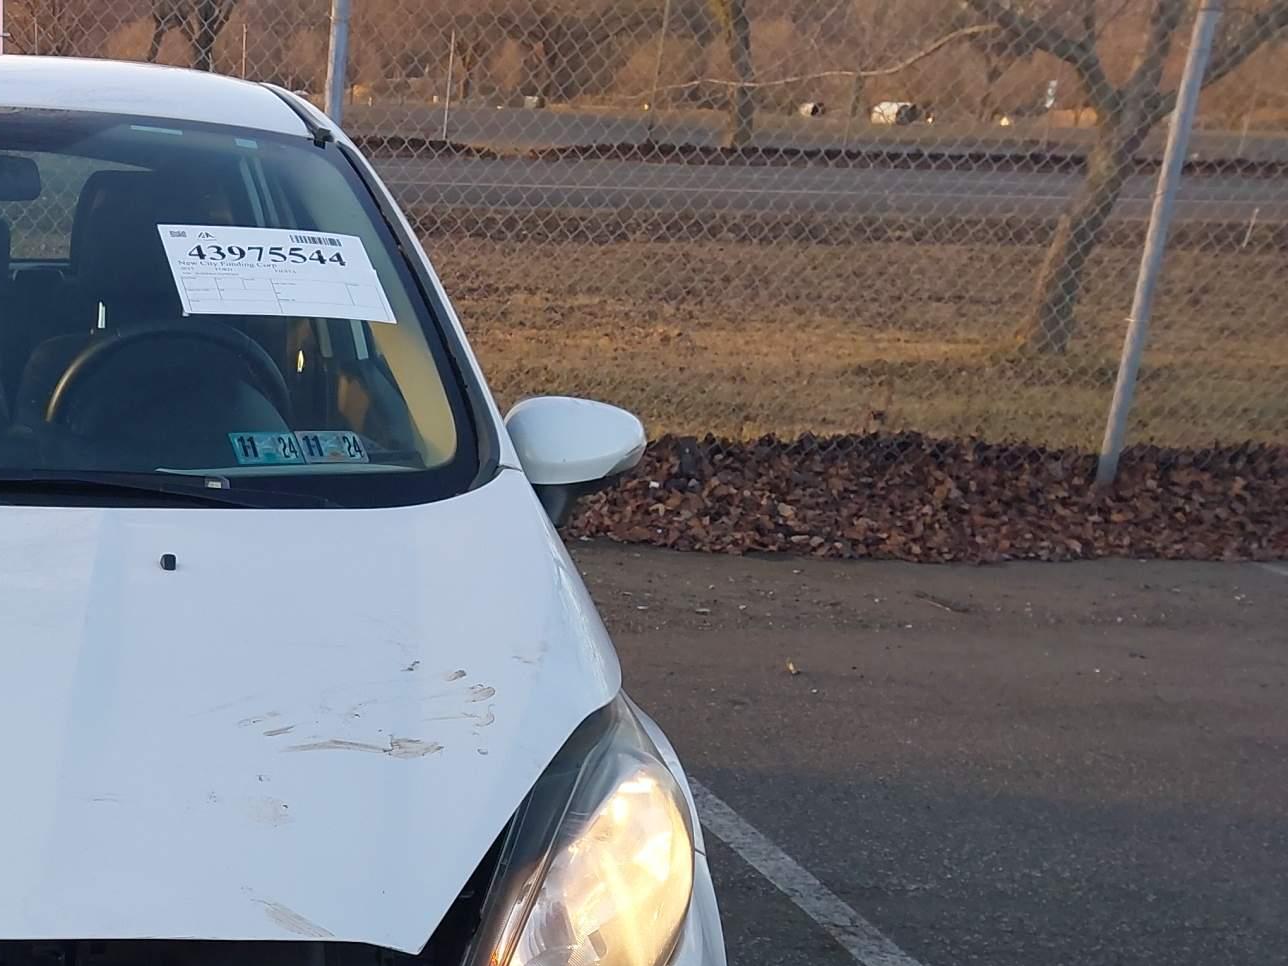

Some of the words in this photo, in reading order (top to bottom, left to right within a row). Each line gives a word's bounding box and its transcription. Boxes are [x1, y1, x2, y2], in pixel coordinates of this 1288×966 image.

[188, 243, 347, 267] 43975544
[277, 436, 299, 459] 24
[342, 435, 364, 458] 24
